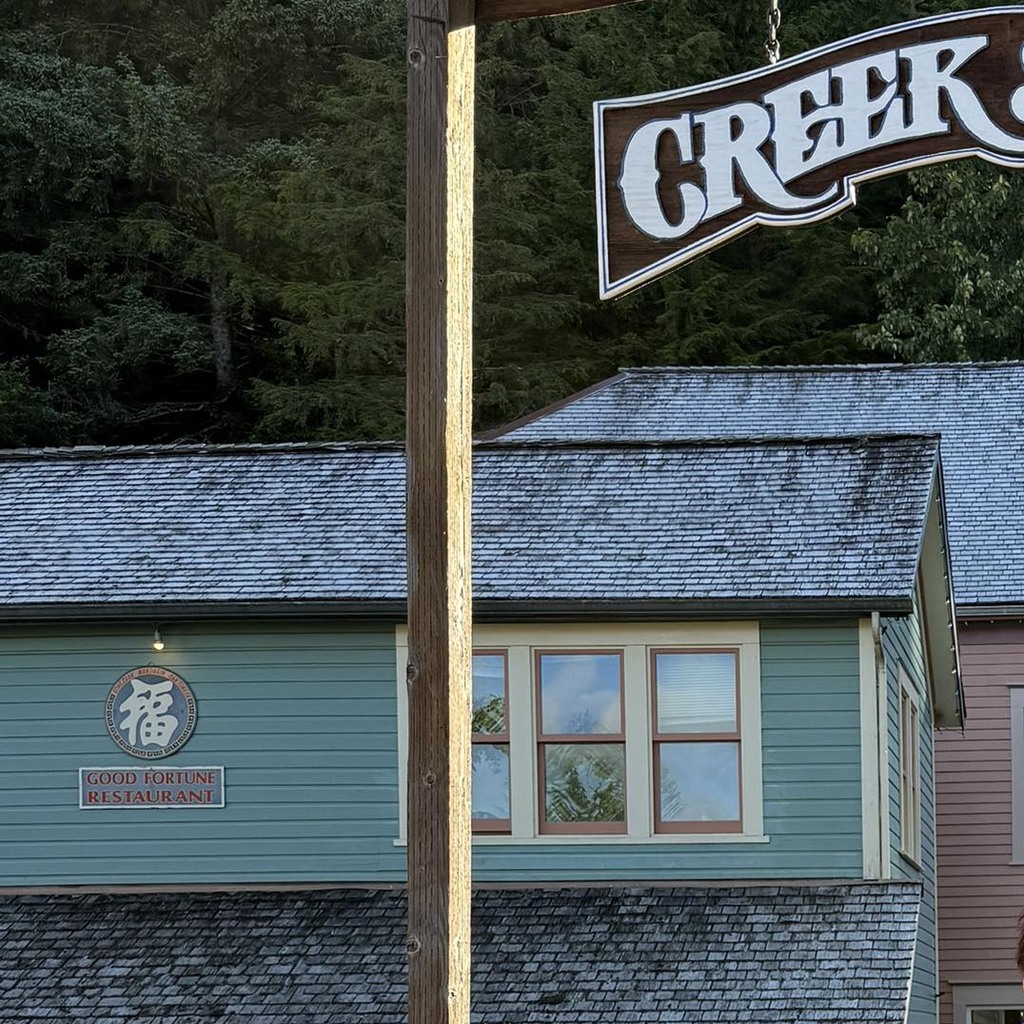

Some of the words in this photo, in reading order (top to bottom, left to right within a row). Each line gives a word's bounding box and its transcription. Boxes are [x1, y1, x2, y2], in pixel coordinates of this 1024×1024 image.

[119, 678, 179, 747] 福
[87, 772, 137, 785] GOOD
[144, 771, 216, 785] FORTUNE
[87, 790, 215, 804] RESTAURANT
